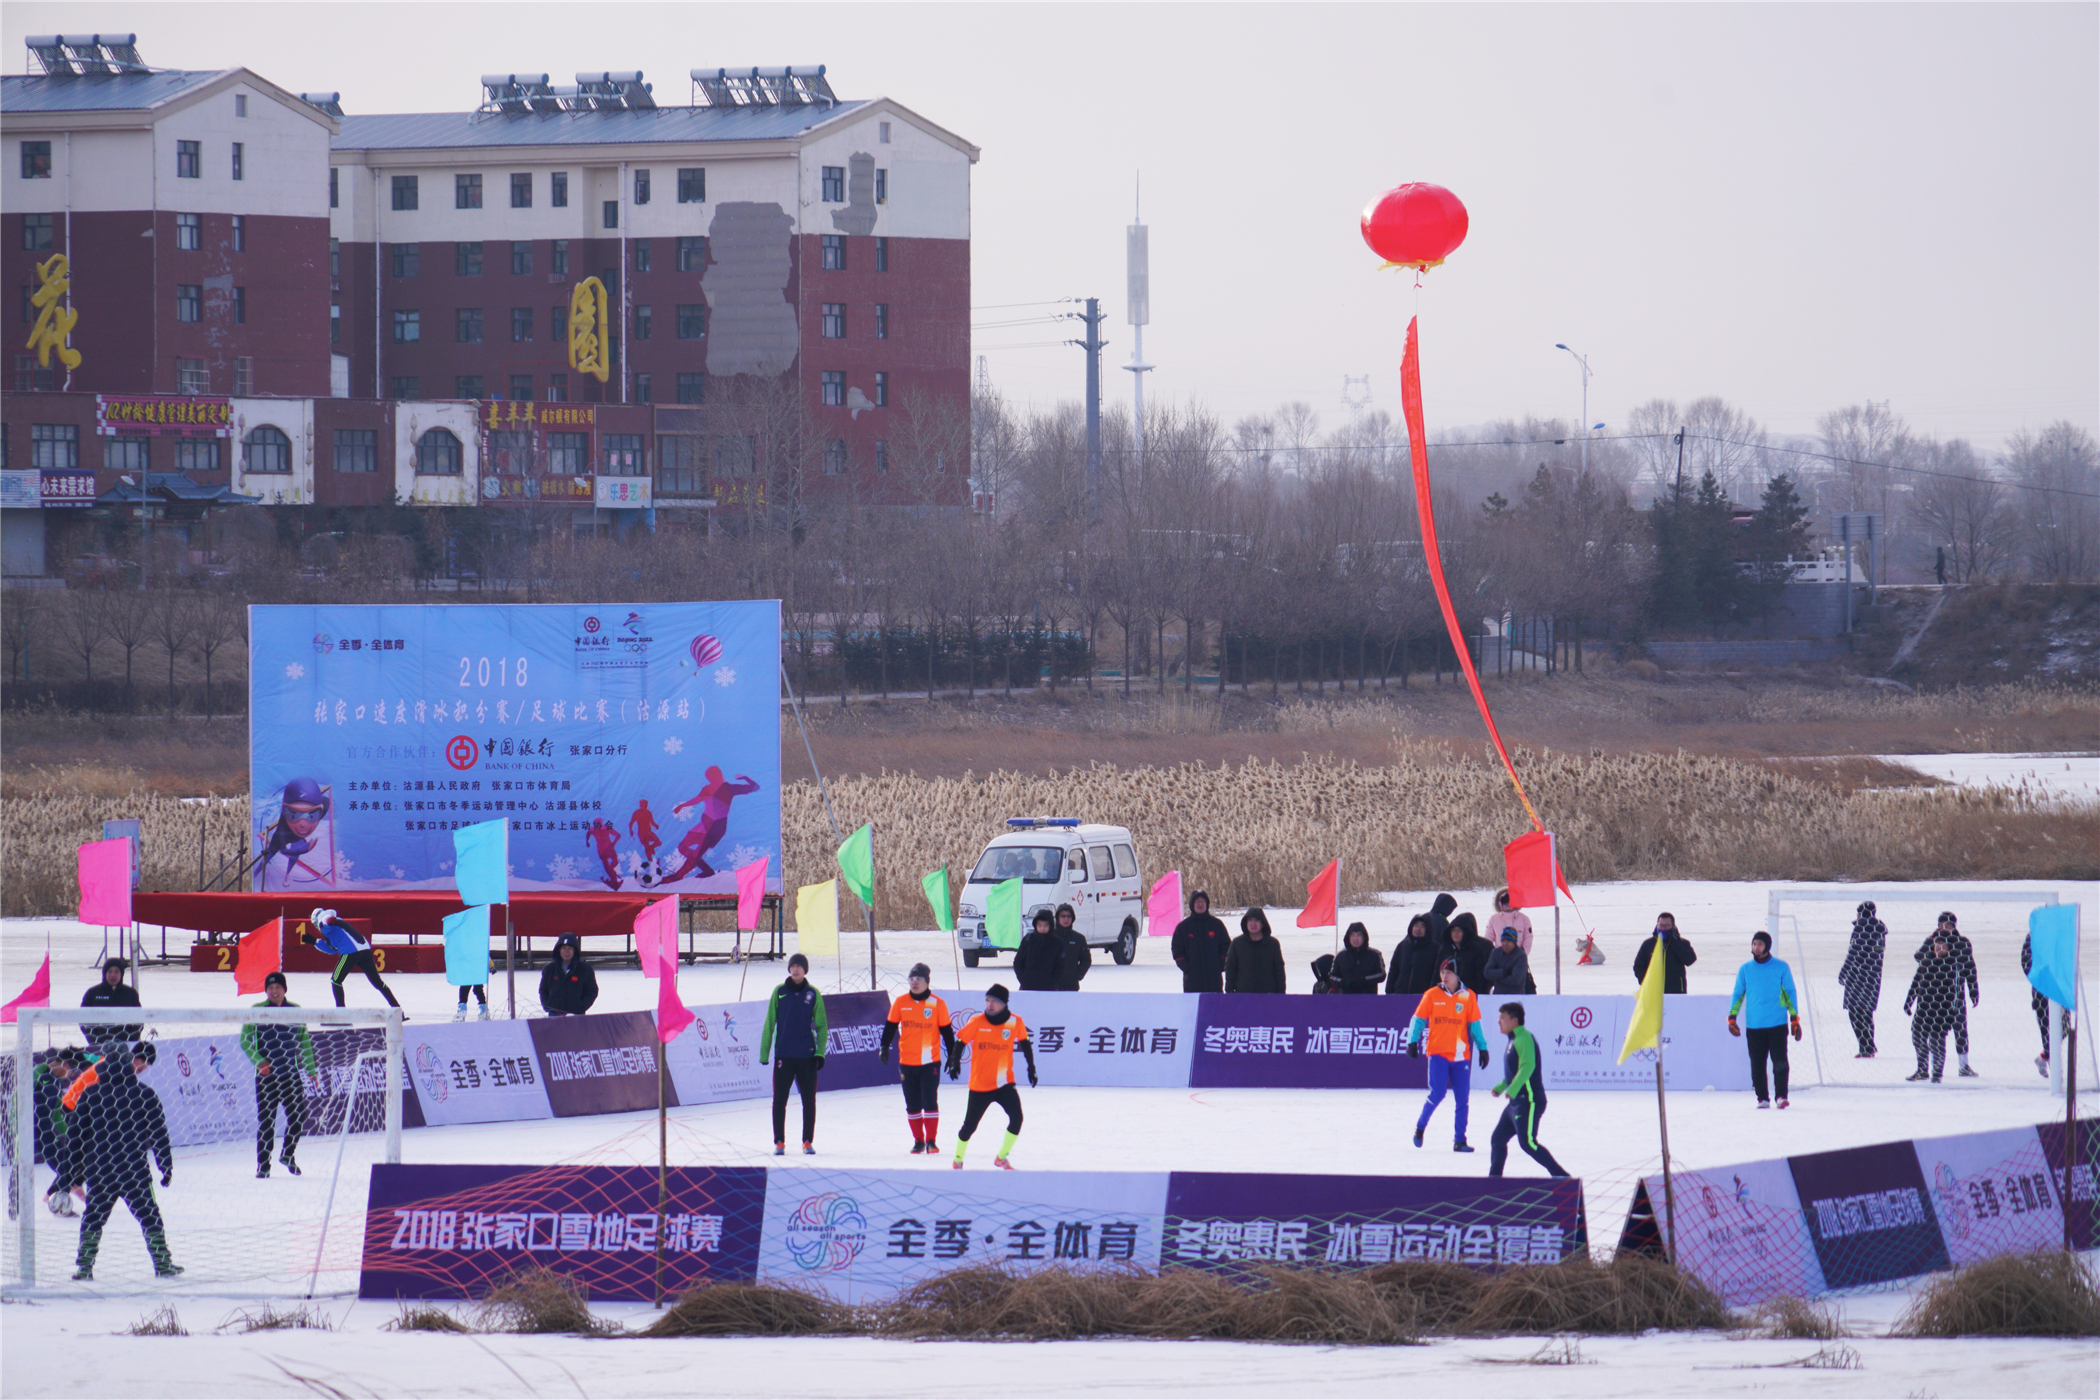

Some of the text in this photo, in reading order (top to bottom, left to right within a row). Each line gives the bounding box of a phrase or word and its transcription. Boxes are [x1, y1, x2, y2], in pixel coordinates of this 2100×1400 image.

[485, 401, 537, 430] 喜羊羊
[610, 483, 650, 502] 乐思艺术
[459, 656, 529, 687] 2018
[569, 744, 628, 756] 张家口分行
[491, 780, 571, 792] 张家口市体育局
[545, 800, 602, 811] 沽源县体校
[507, 820, 614, 831] 家口市冰上运动协会
[295, 922, 306, 945] 1
[217, 947, 231, 971] 2
[373, 949, 386, 972] 3
[1203, 1025, 1295, 1055] 冬奥惠民
[391, 1210, 724, 1253] 2018张家口雪地足球赛
[835, 1233, 866, 1242] sports
[886, 1218, 1139, 1261] 全季·全体育
[1174, 1219, 1564, 1266] 冬奥惠民 冰雪运动全覆盖
